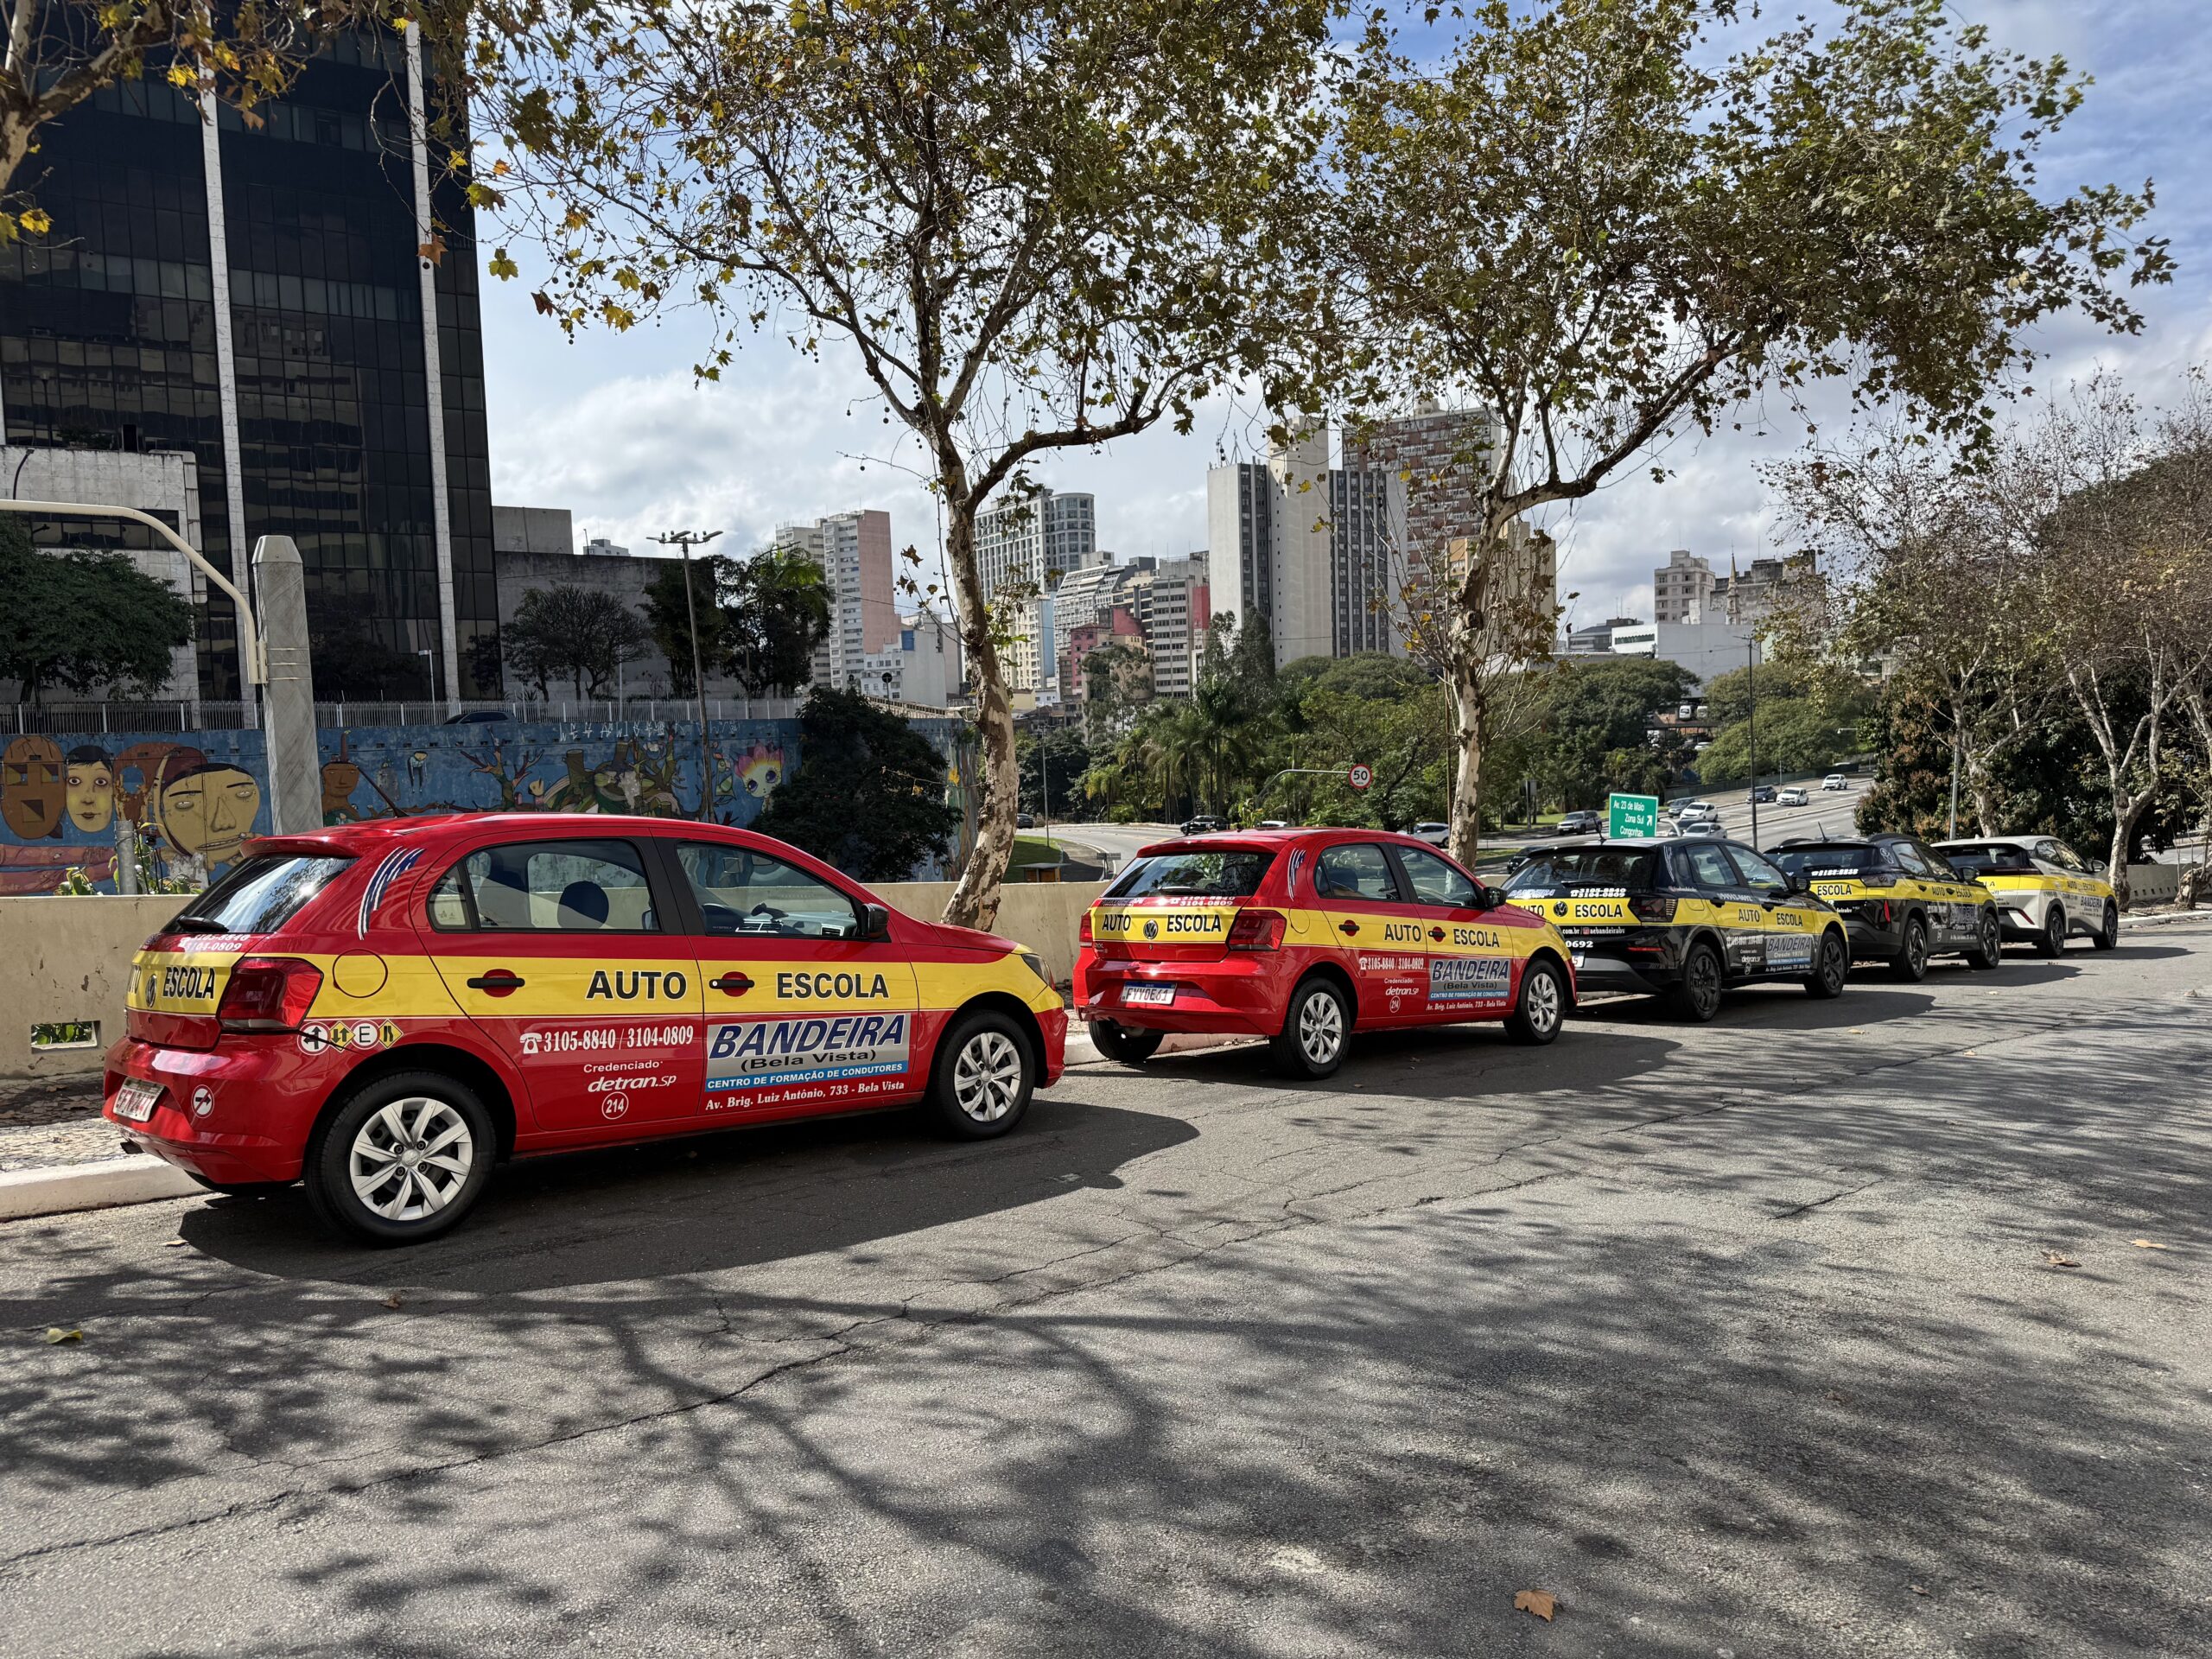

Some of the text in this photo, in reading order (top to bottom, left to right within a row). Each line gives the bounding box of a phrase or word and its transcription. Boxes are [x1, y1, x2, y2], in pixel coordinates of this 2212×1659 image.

[1353, 770, 1368, 780] 50
[1621, 800, 1626, 809] 23
[1627, 802, 1633, 810] de
[1634, 802, 1644, 811] Maio
[1625, 813, 1636, 823] Zona
[1620, 825, 1643, 837] Congonhas
[1817, 884, 1853, 896] ESCOLA
[1575, 904, 1624, 918] ESCOLA
[1738, 909, 1803, 926] AUTO ESCOLA
[1102, 914, 1221, 932] AUTO ESCOLA
[1384, 924, 1500, 948] AUTO ESCOLA
[1767, 938, 1811, 951] BANDEIRA
[1367, 957, 1395, 970] 3105-8840
[1431, 960, 1509, 982] BANDEIRA
[162, 966, 216, 999] ESCOLA
[586, 969, 890, 1000] AUTO ESCOLA
[1443, 982, 1468, 990] (Bela
[543, 1030, 616, 1052] 3105-8840
[626, 1026, 694, 1047] 3104-0809
[708, 1014, 906, 1059] BANDEIRA
[741, 1049, 876, 1072] (Bela Vista)
[708, 1064, 902, 1090] CENTRO DE FORMAÇÃO DE CONDUTORES
[705, 1099, 723, 1110] Av.
[727, 1096, 753, 1109] Brig.
[757, 1092, 780, 1104] Luiz
[782, 1088, 826, 1102] Antônio,
[830, 1085, 849, 1096] 733
[858, 1083, 879, 1093] Bela
[882, 1081, 905, 1090] Vista
[606, 1098, 624, 1113] 214
